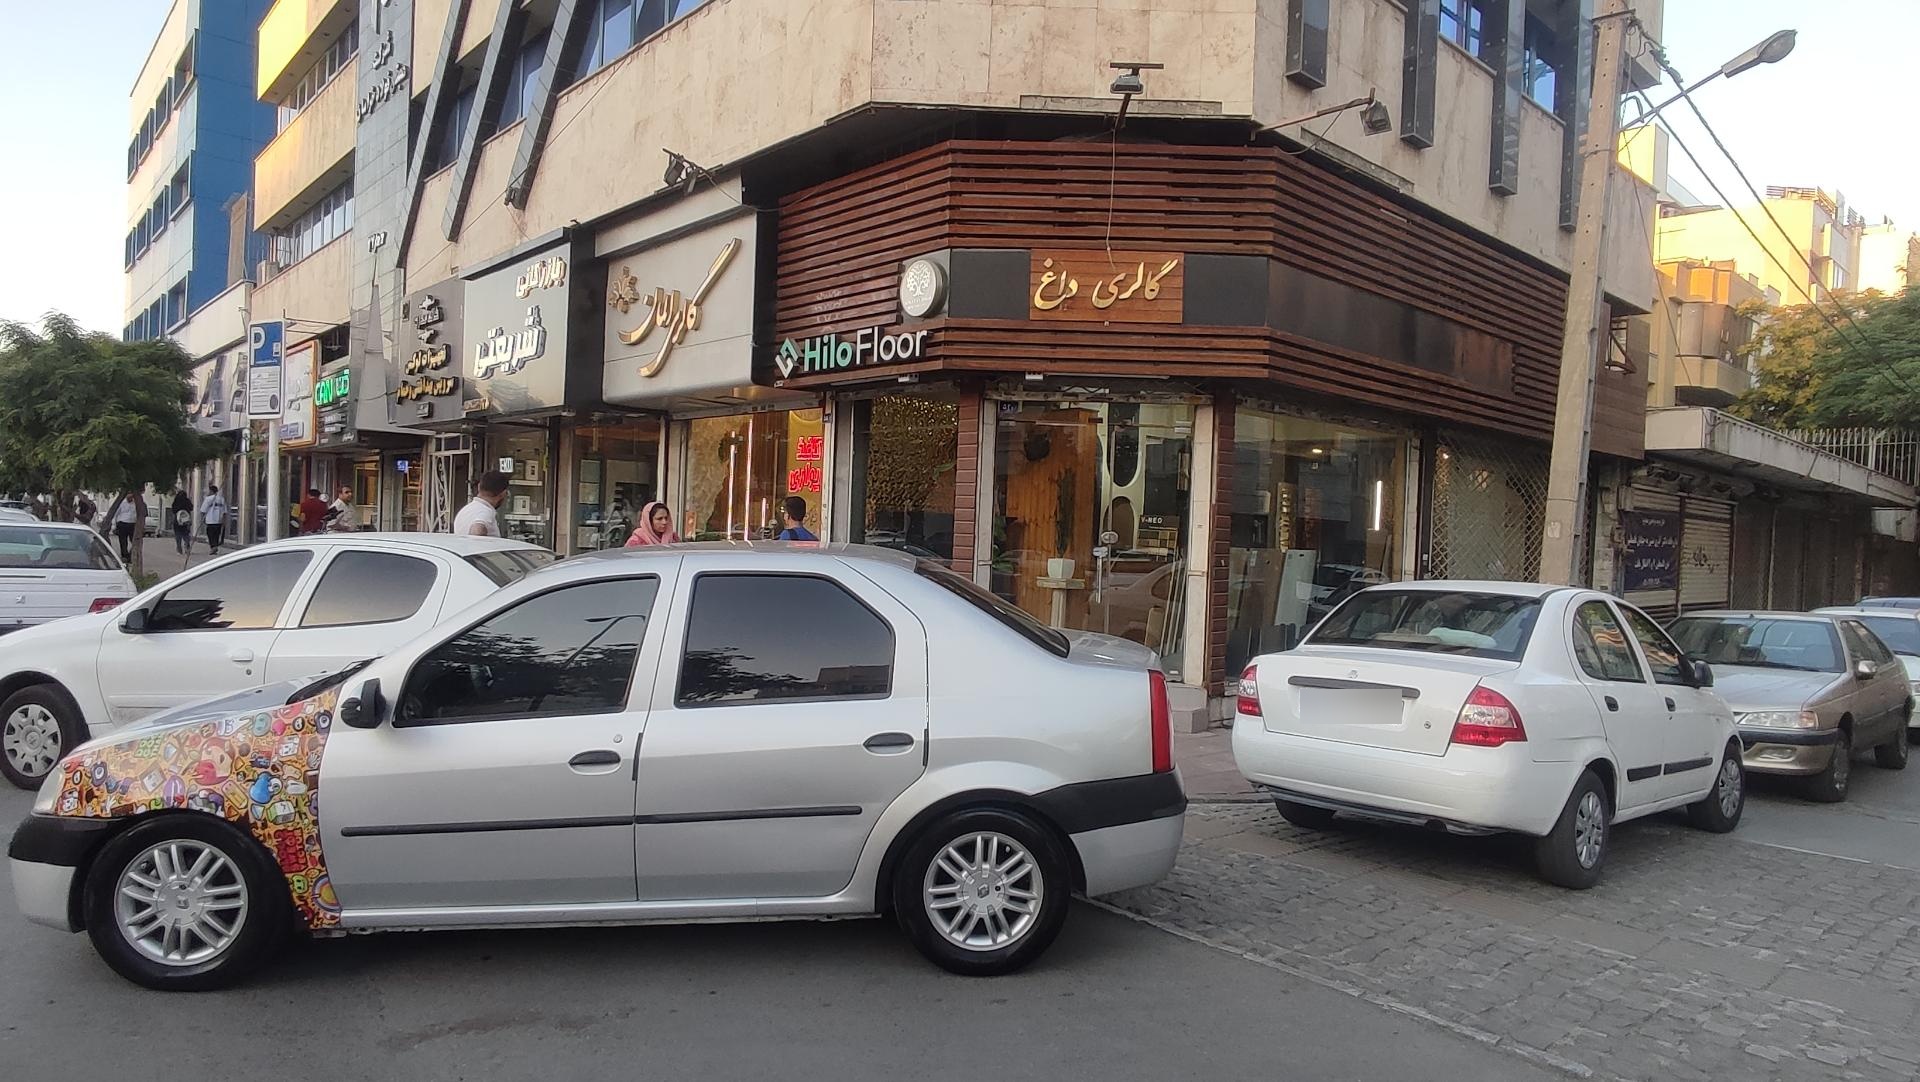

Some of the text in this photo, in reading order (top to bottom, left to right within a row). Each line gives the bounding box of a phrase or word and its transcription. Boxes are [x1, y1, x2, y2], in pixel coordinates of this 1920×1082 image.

[515, 256, 567, 298] بازرگانی
[1034, 257, 1179, 310] گالری داغ
[250, 326, 266, 366] P
[474, 305, 547, 380] شریعتی
